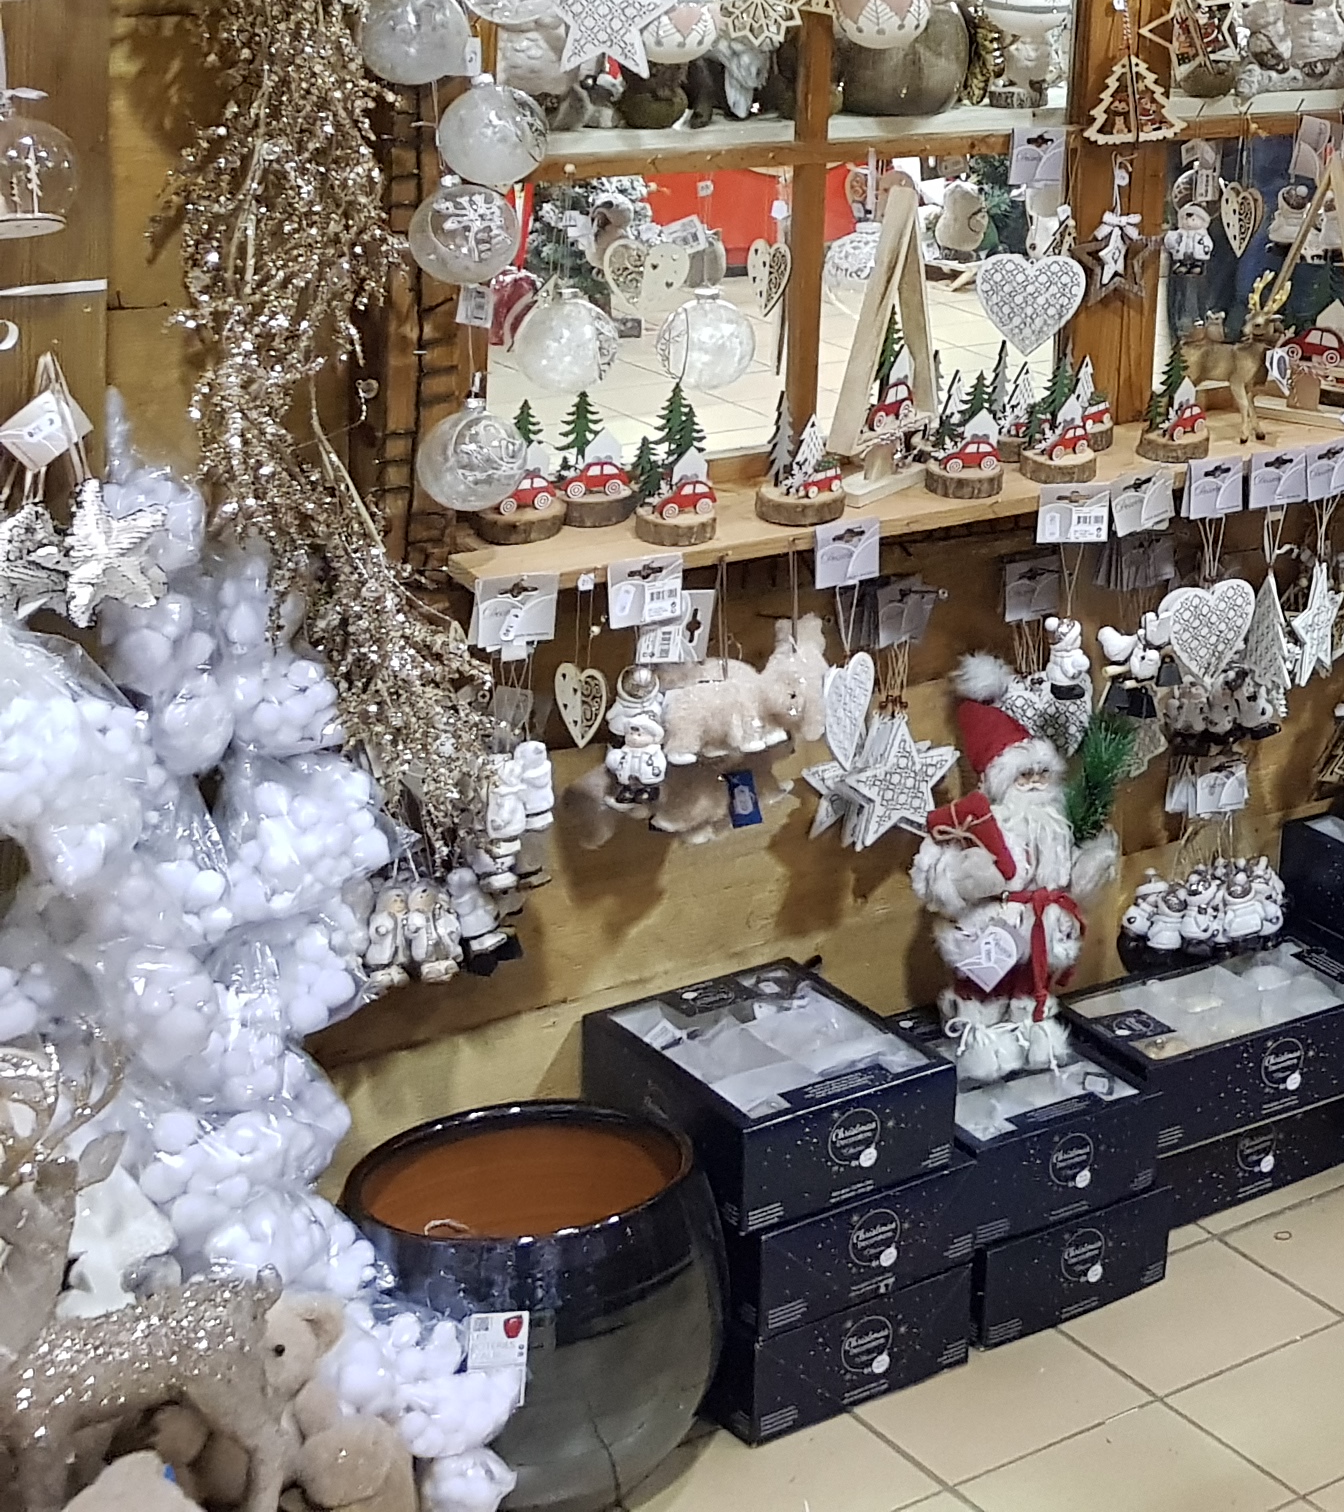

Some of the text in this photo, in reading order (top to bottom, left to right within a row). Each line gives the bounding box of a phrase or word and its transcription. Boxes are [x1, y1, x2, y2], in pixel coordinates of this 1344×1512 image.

[832, 1121, 877, 1142] Christmas
[853, 1221, 896, 1244] Christmas
[845, 1327, 890, 1351] Christmas
